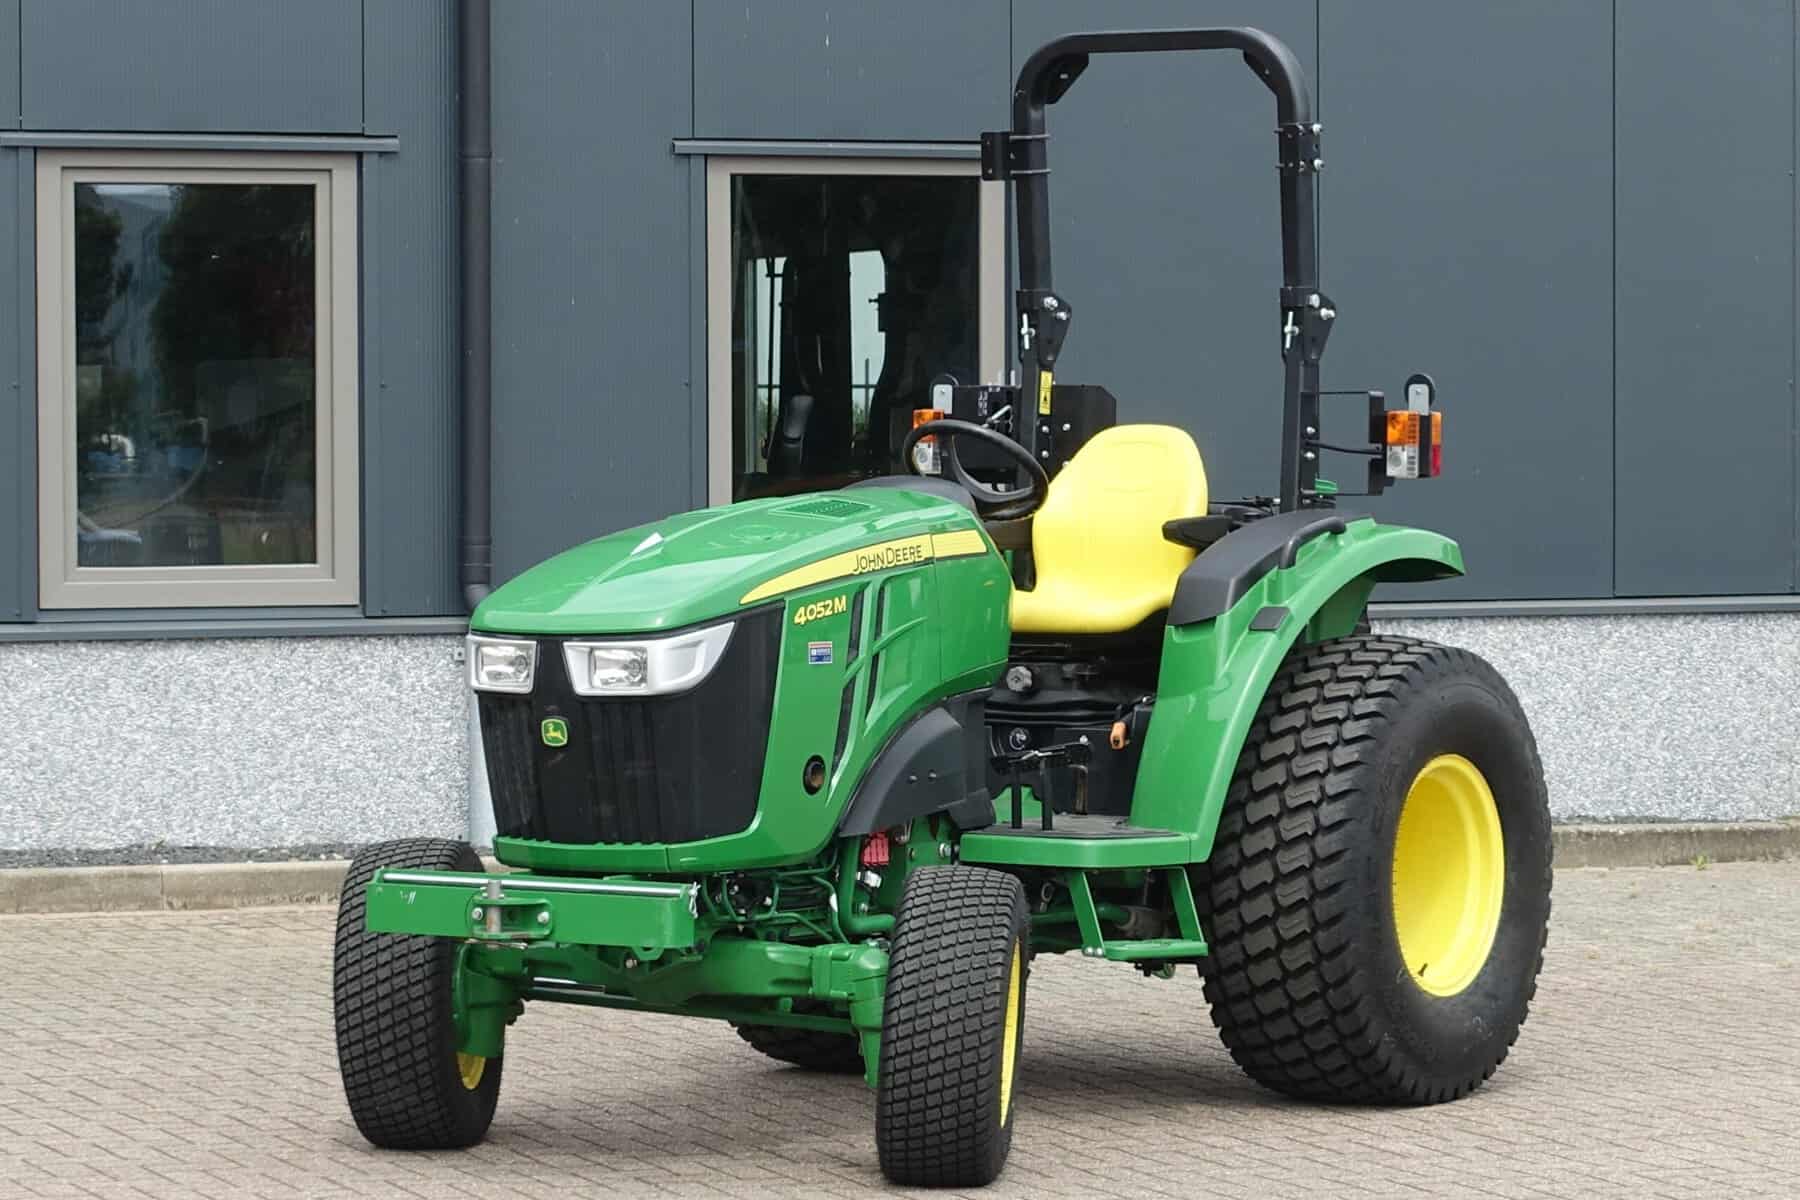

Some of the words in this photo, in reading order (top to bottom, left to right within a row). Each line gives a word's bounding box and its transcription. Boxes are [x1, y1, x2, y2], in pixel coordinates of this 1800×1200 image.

[853, 551, 885, 573] JOHN
[886, 545, 922, 565] DEERE
[794, 595, 847, 624] 4052M
